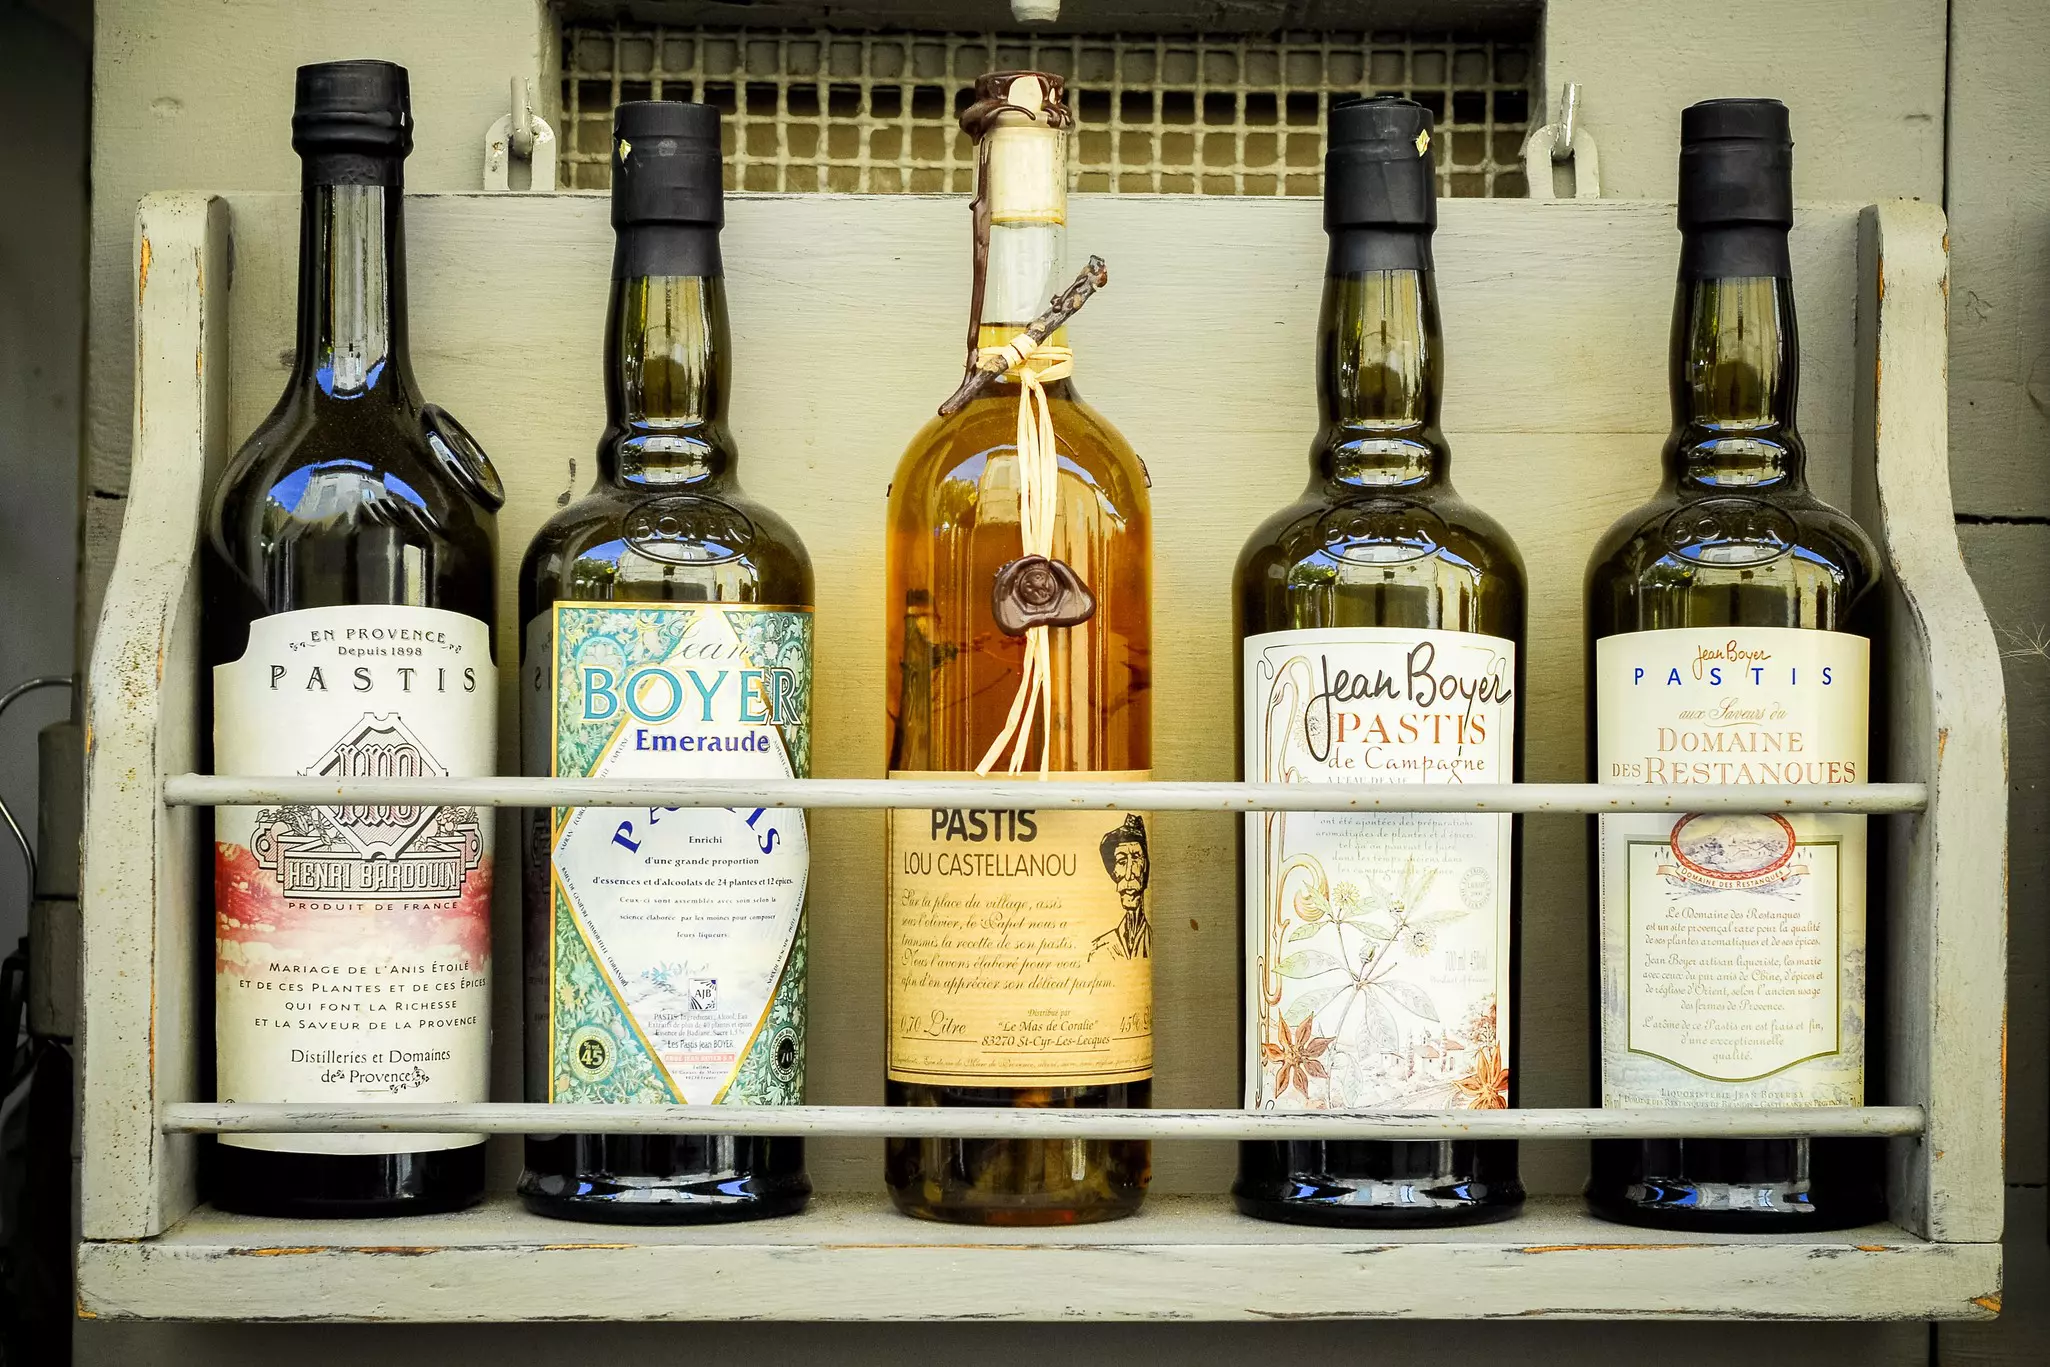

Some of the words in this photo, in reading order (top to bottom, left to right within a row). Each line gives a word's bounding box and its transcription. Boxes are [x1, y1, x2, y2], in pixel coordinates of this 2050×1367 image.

[311, 630, 335, 643] EN
[346, 628, 446, 644] PROVENCE
[338, 646, 387, 657] Depuis
[392, 646, 423, 657] 1898
[1692, 644, 1724, 680] Jean
[1726, 640, 1771, 678] Boyer
[269, 665, 477, 693] PASTIS
[1634, 667, 1833, 686] PASTIS
[583, 665, 801, 725] BOYER
[1305, 654, 1400, 762] Jean
[1406, 641, 1512, 735] Boyer
[1678, 709, 1706, 720] aux
[1709, 697, 1765, 721] Saveurs
[1769, 701, 1788, 720] du
[1336, 712, 1487, 745] PASTIS
[636, 729, 770, 752] Emeraude
[1657, 727, 1804, 752] DOMAINE
[1329, 746, 1355, 769] de
[1364, 746, 1485, 784] Campagne
[1612, 763, 1641, 777] DES
[1644, 757, 1856, 785] RESTANQUES
[931, 809, 1038, 842] PASTIS
[1399, 816, 1414, 826] des
[688, 836, 722, 844] Enrichi
[644, 857, 672, 865] d'une
[674, 857, 709, 867] grande
[712, 858, 759, 867] proportion
[904, 852, 932, 875] LOU
[937, 852, 1077, 877] CASTELLANOU
[288, 861, 351, 890] HENRI
[360, 861, 458, 890] BARDOUIN
[592, 877, 640, 885] d'essences
[654, 878, 703, 886] d'alcoolats
[729, 878, 757, 887] plantes
[767, 877, 774, 885] 12
[288, 902, 363, 912] PRODUIT
[375, 902, 394, 912] DE
[403, 901, 458, 912] FRANCE
[921, 895, 931, 907] la
[931, 893, 961, 913] place
[965, 893, 980, 908] du
[1036, 896, 1062, 909] assis
[966, 914, 977, 928] le
[1028, 921, 1056, 929] nous
[1059, 921, 1067, 929] a
[1665, 906, 1679, 918] Le
[1682, 907, 1728, 919] Domaine
[1730, 909, 1744, 919] des
[1746, 908, 1801, 922] Restanques
[1646, 923, 1656, 931] est
[1670, 923, 1686, 932] site
[1757, 926, 1777, 937] pour
[1780, 921, 1788, 933] la
[1791, 920, 1821, 936] qualité
[901, 934, 938, 947] transmis
[941, 934, 952, 948] la
[956, 937, 993, 949] recette
[997, 934, 1011, 948] de
[1014, 940, 1036, 949] son
[901, 948, 928, 967] Nous
[1018, 957, 1052, 975] pour
[1056, 960, 1081, 969] vous
[1645, 953, 1666, 967] Jean
[1668, 953, 1697, 969] Boyer
[1699, 957, 1733, 966] artisan
[1784, 954, 1795, 966] les
[1796, 957, 1821, 966] marie
[348, 966, 367, 976] DE
[239, 979, 251, 989] ET
[257, 980, 272, 990] DE
[279, 982, 304, 992] CES
[389, 984, 405, 993] ET
[412, 983, 429, 992] DE
[435, 981, 456, 991] CES
[919, 972, 940, 988] d'en
[943, 976, 1000, 995] apprécier
[1003, 981, 1024, 990] son
[694, 989, 712, 999] AJB
[285, 1001, 312, 1012] QUI
[320, 1002, 361, 1013] FONT
[369, 1003, 387, 1012] LA
[255, 1018, 268, 1027] ET
[275, 1019, 291, 1029] LA
[369, 1022, 387, 1031] DE
[395, 1021, 412, 1031] LA
[924, 1009, 967, 1037] Litre
[1019, 1020, 1044, 1032] Mas
[1046, 1020, 1058, 1032] de
[981, 1036, 1015, 1047] 83270
[291, 1049, 367, 1064] Distilleries
[372, 1052, 384, 1064] et
[389, 1048, 451, 1064] Domaines
[581, 1049, 603, 1065] 45
[321, 1069, 336, 1083] de
[350, 1069, 411, 1083] Provence
